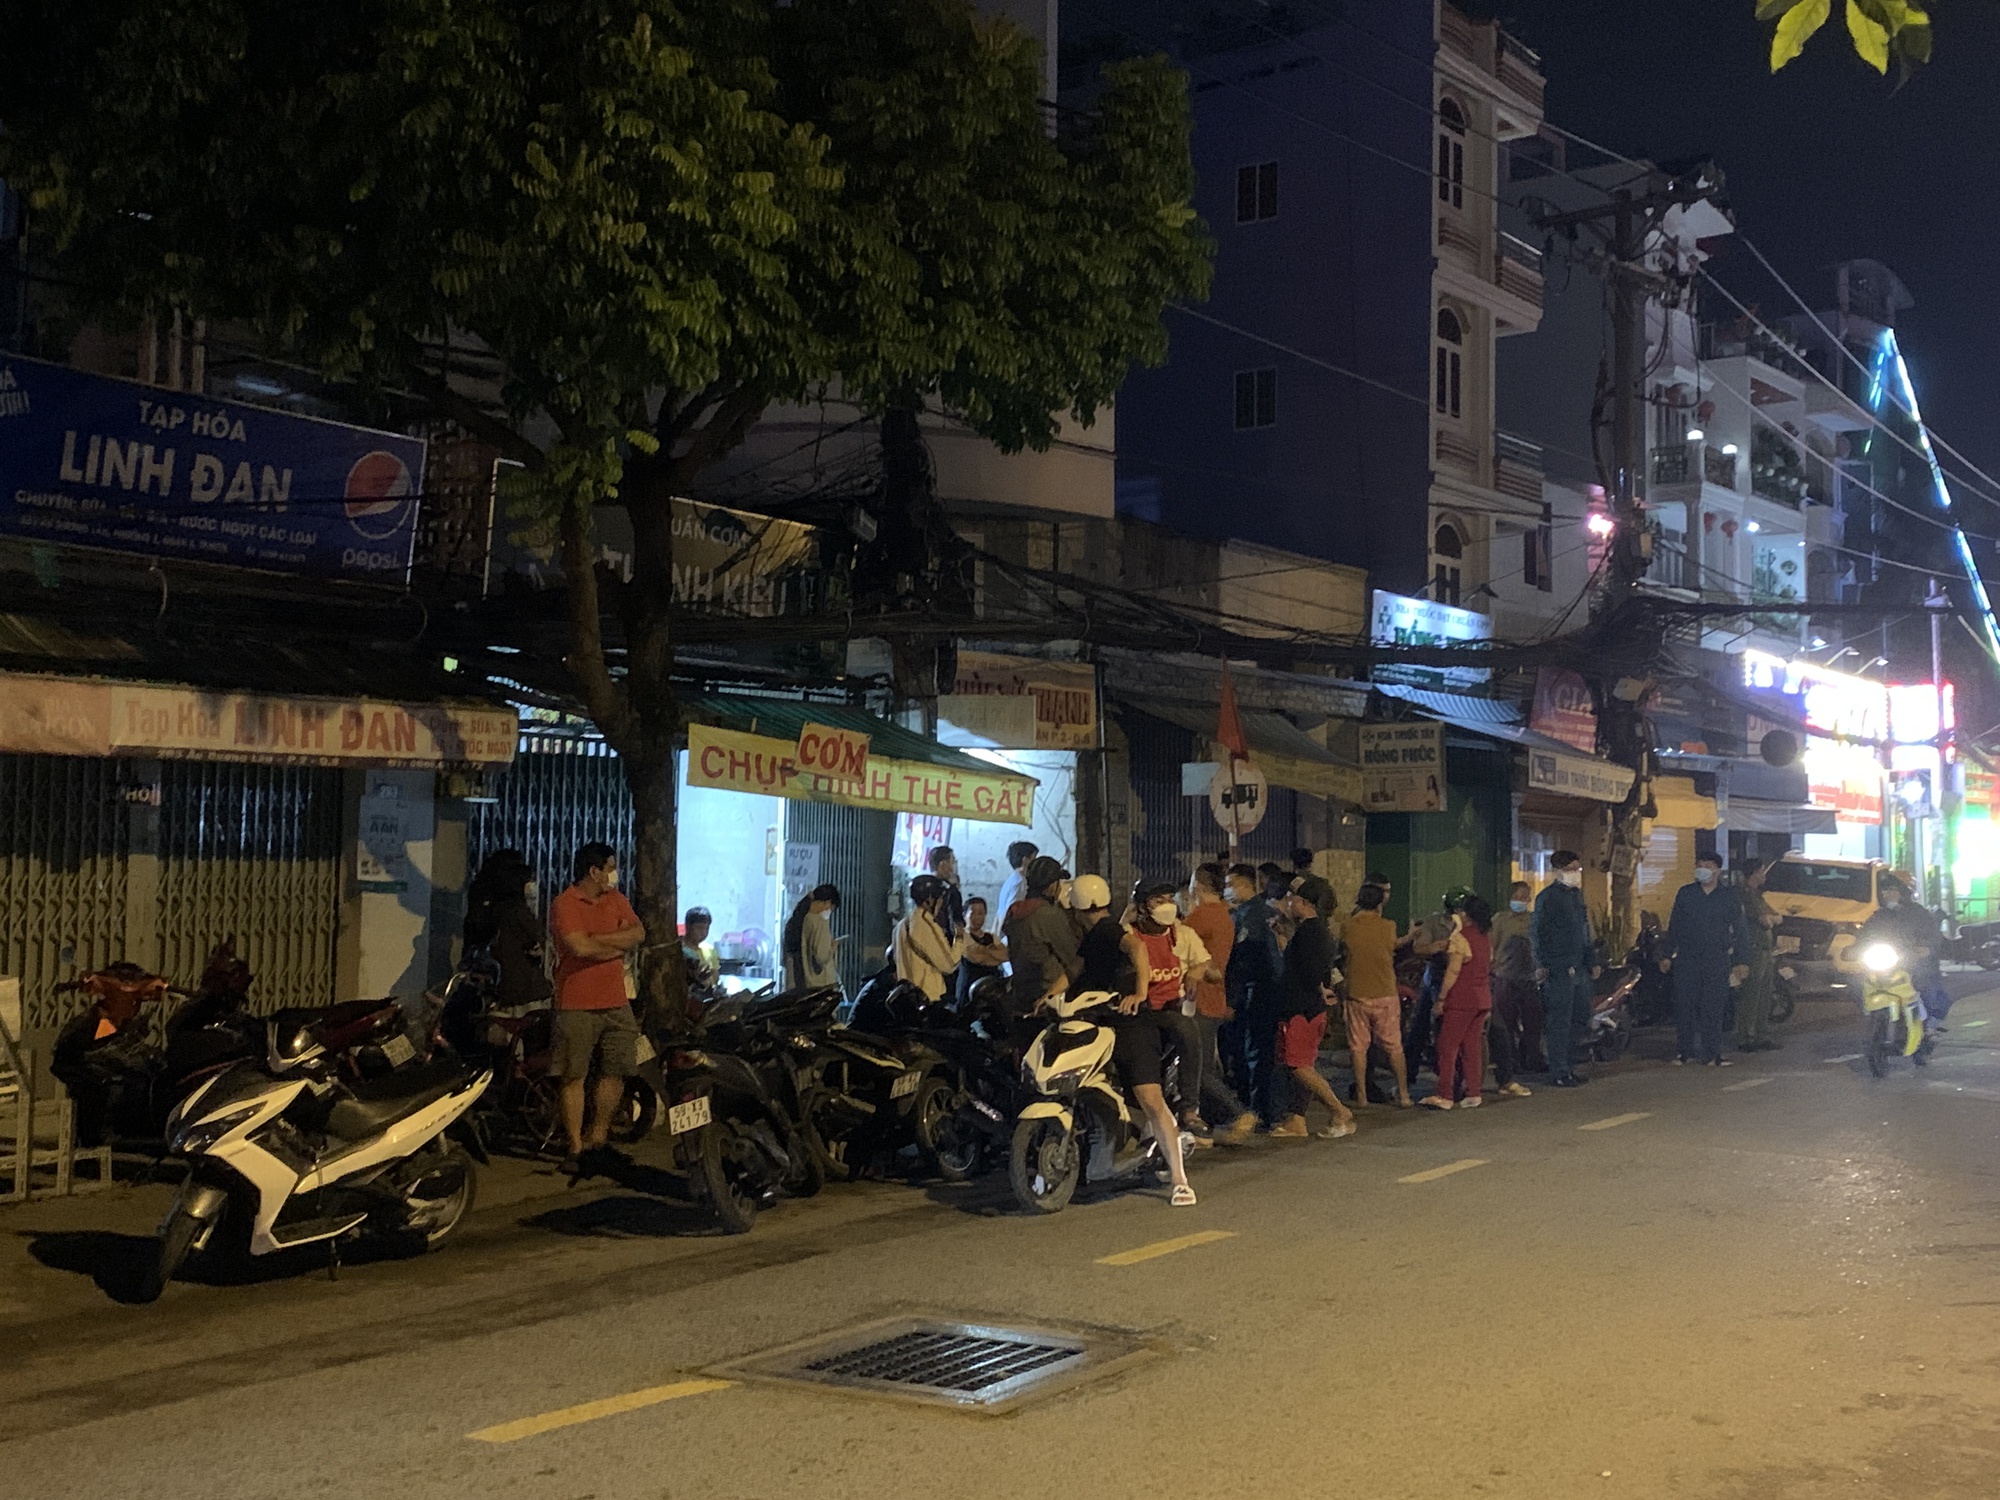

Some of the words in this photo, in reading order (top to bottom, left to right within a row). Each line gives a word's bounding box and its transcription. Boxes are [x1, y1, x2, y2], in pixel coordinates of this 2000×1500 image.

[139, 400, 186, 435] TẠP
[191, 409, 247, 443] HÓA
[59, 430, 176, 496] LINH
[190, 453, 293, 513] ĐAN
[670, 514, 706, 541] UÁN
[233, 701, 325, 749] LINH
[339, 706, 416, 752] ĐAN
[700, 746, 799, 791] CHỤP
[799, 733, 868, 782] CƠM
